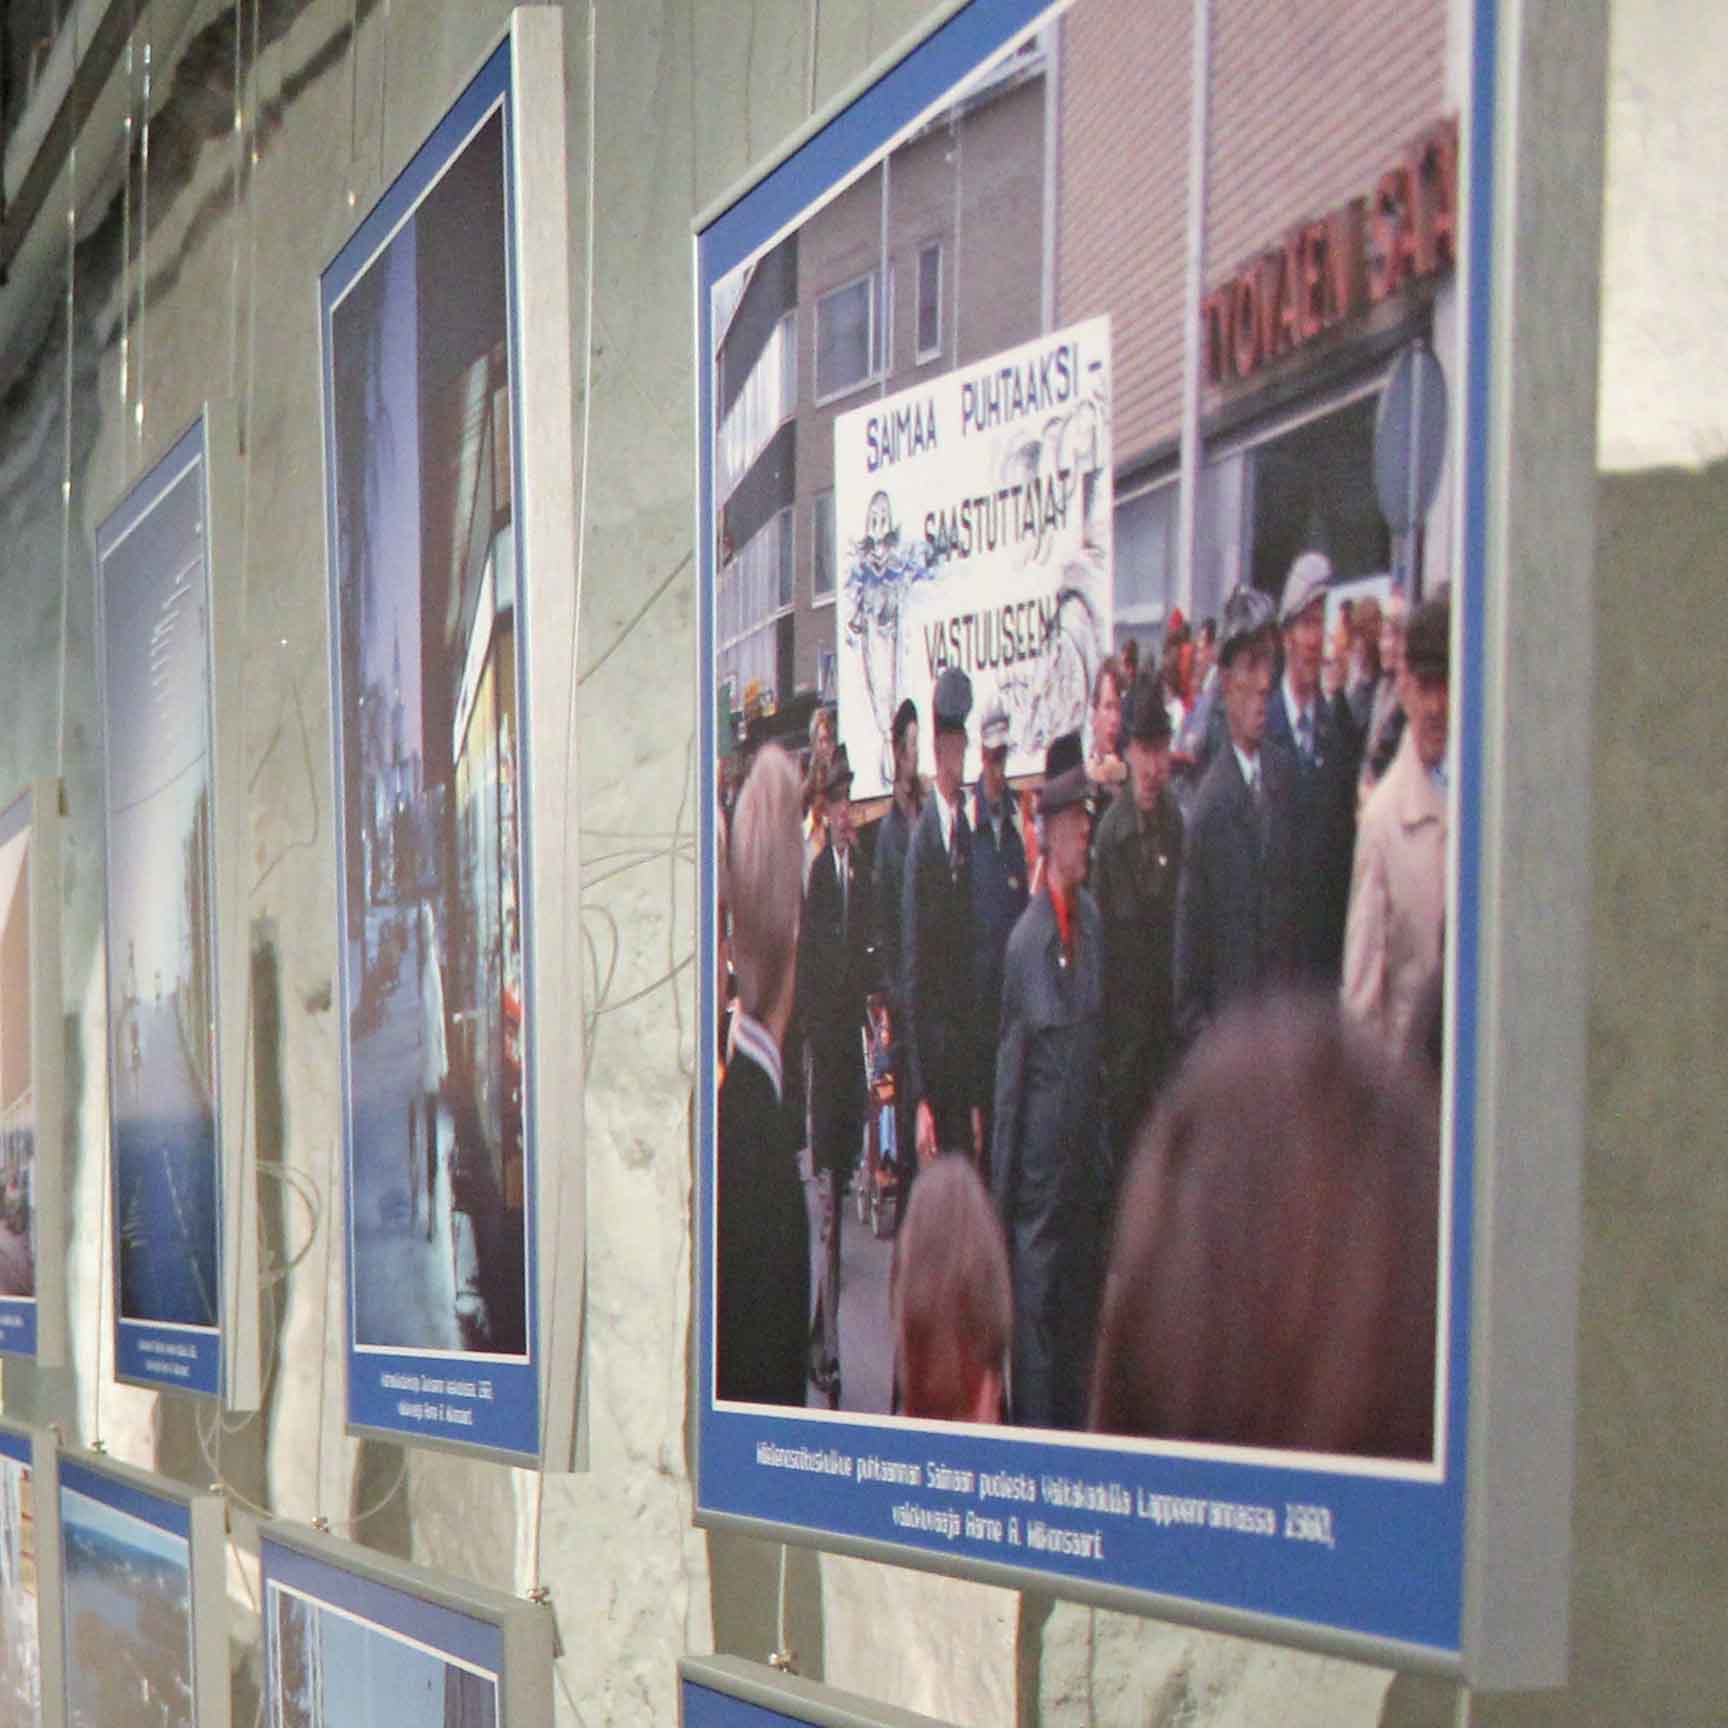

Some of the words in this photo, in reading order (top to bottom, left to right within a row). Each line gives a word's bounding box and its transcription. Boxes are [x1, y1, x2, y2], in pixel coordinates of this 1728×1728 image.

[865, 396, 939, 473] SAIMAA
[961, 340, 1080, 436] PUHTAAKSI
[923, 468, 1072, 570] SAASTUTTAJAT
